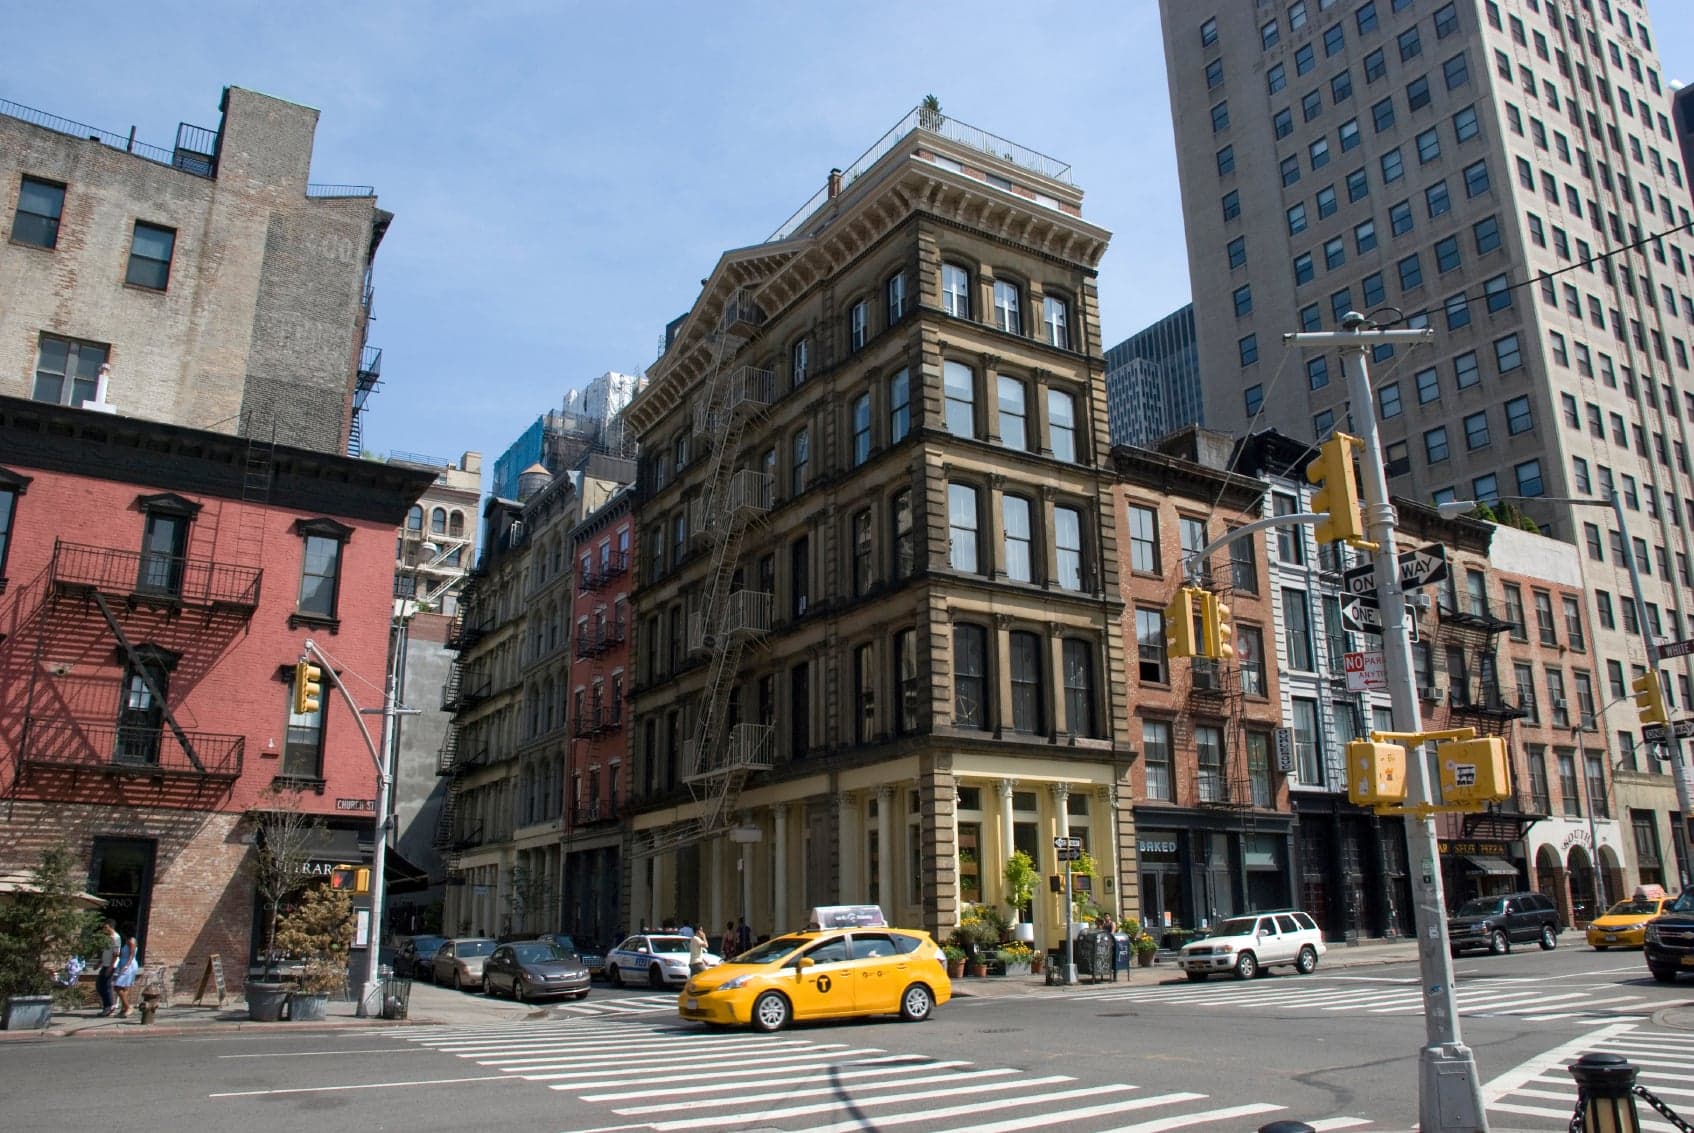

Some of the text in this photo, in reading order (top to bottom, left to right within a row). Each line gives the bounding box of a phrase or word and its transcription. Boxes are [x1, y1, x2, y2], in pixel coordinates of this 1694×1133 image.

[1352, 557, 1432, 593] ON WAY
[1352, 606, 1375, 623] ONE
[1665, 643, 1691, 657] WHITE
[1345, 656, 1363, 670] NO
[1675, 725, 1692, 738] WAY
[1139, 840, 1177, 852] BAKED
